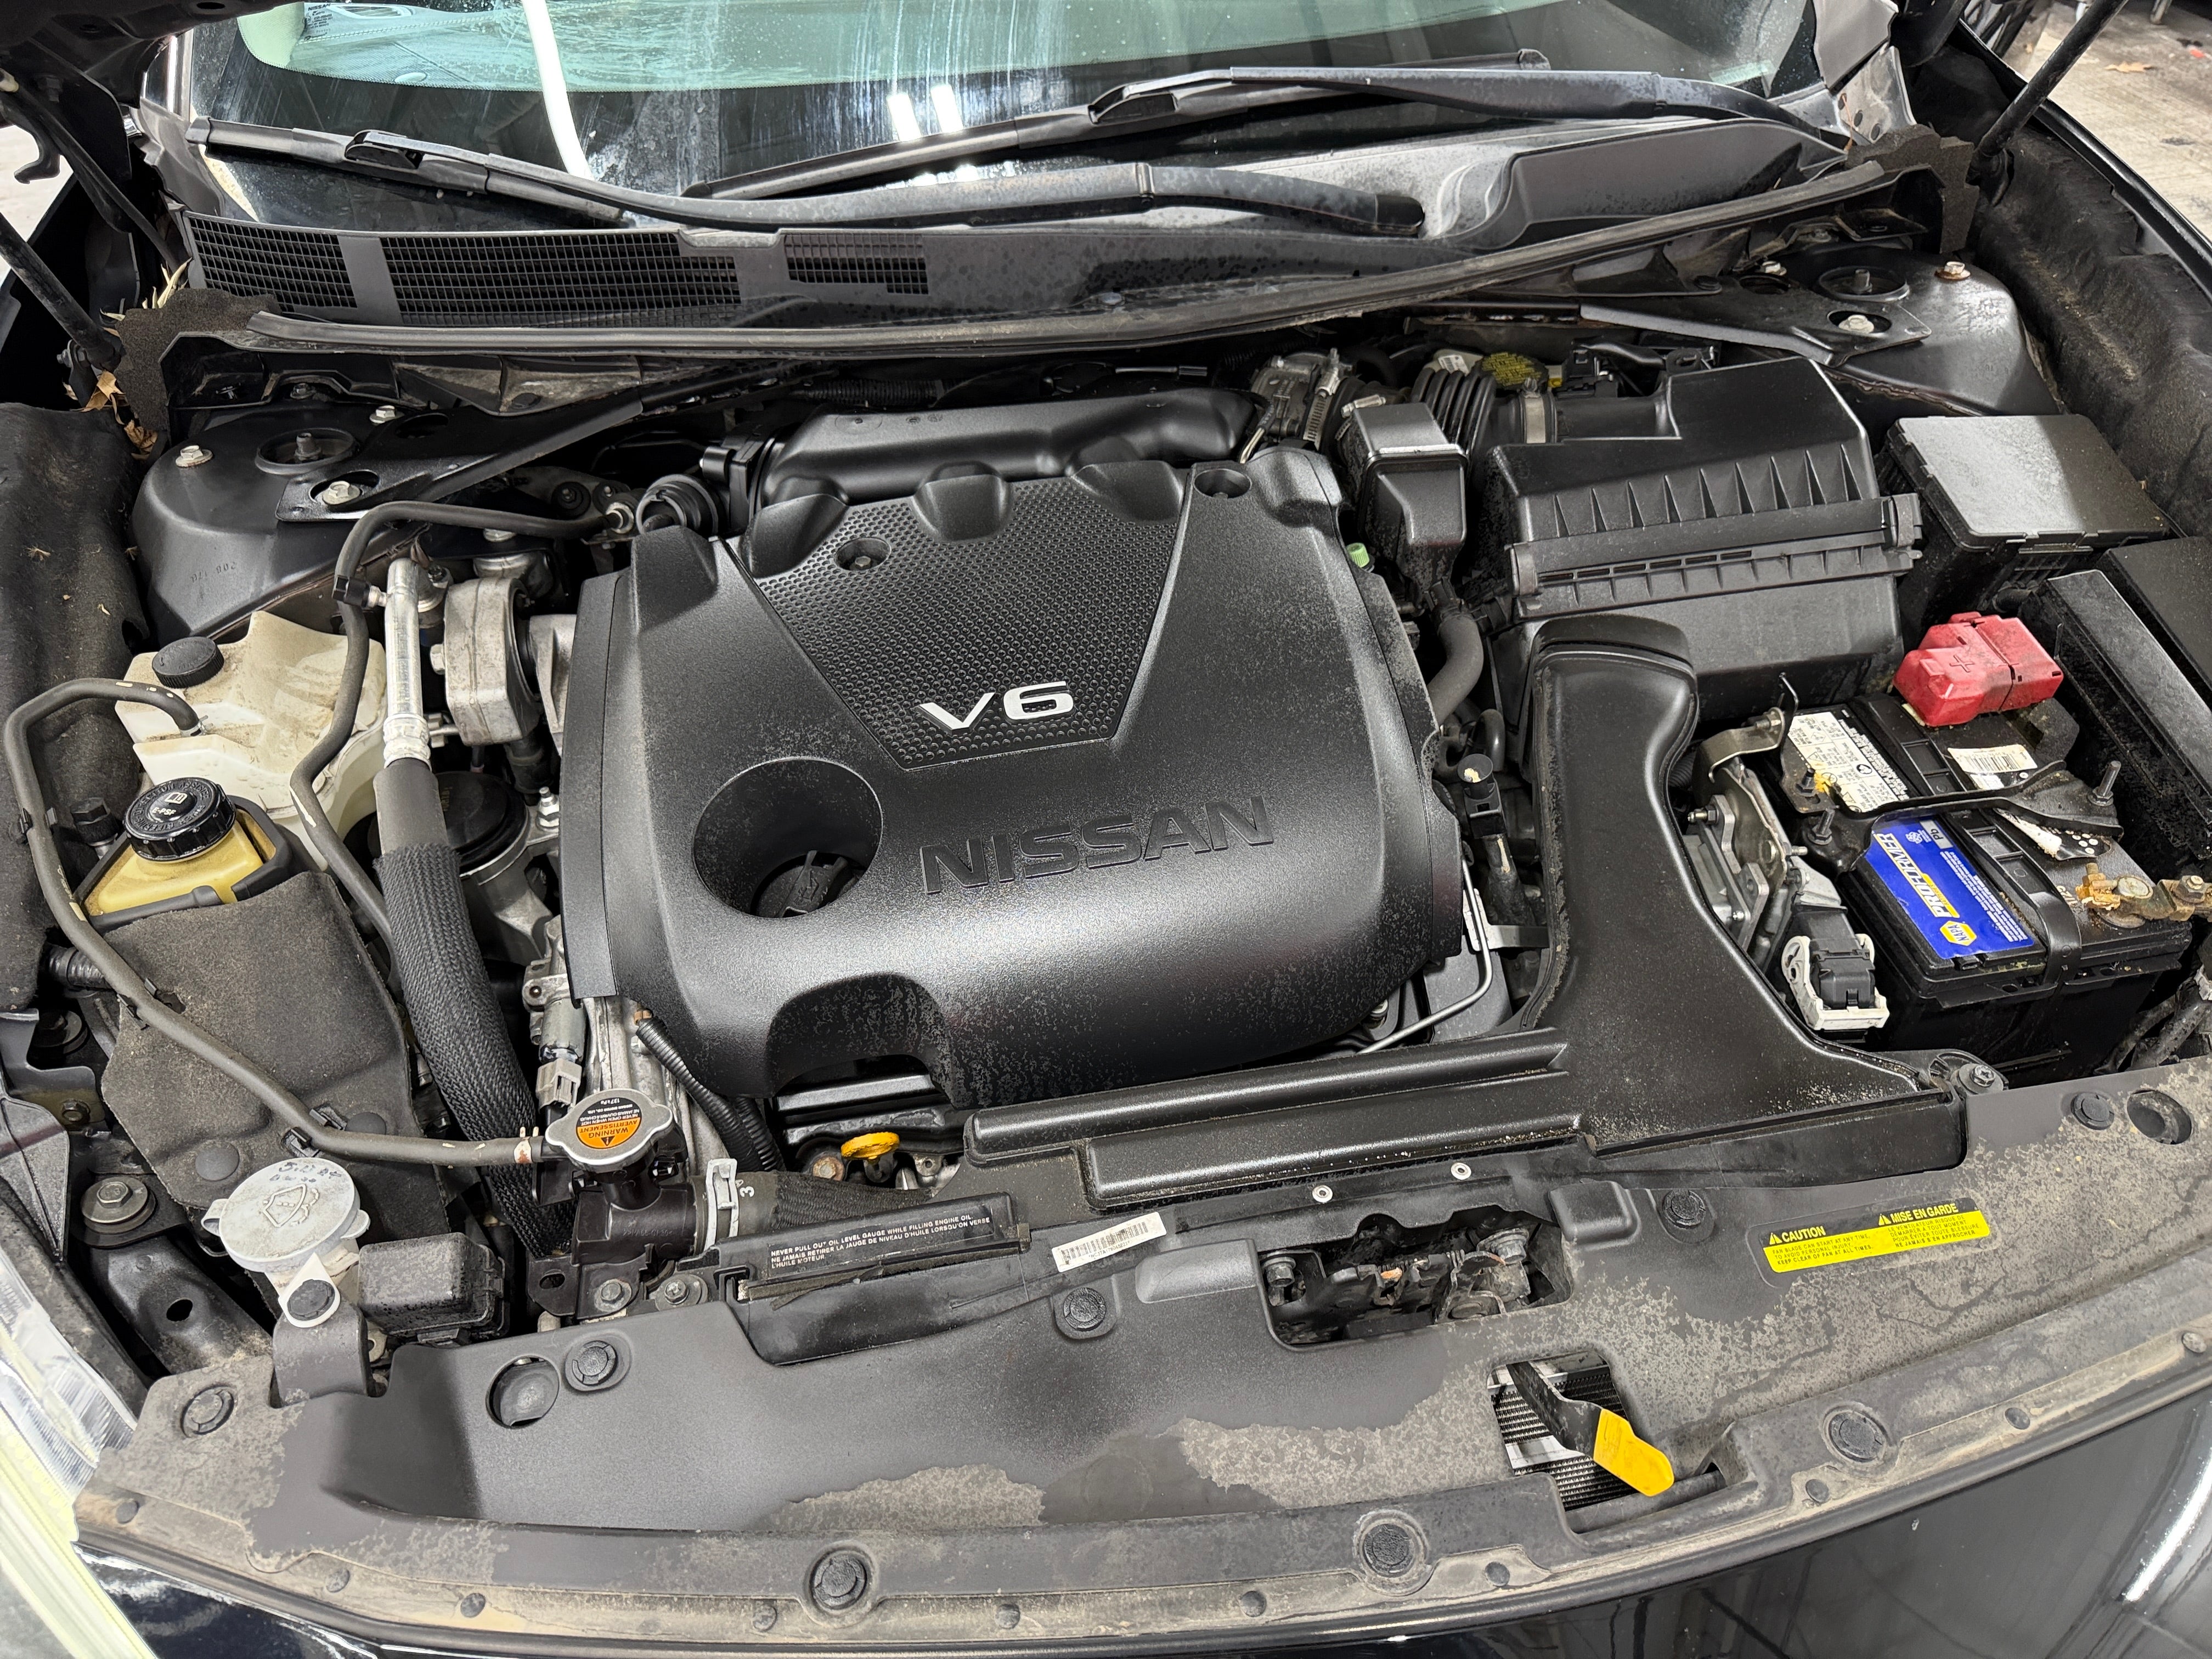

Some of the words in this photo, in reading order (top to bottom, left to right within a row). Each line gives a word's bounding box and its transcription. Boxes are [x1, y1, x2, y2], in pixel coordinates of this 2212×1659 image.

[917, 680, 1074, 733] V6
[151, 806, 177, 816] E-PSF
[1930, 828, 1943, 840] Pb
[920, 795, 1274, 894] NISSAN
[1878, 833, 1953, 917] PROFORMER
[1948, 924, 1970, 942] NAPA
[579, 1119, 637, 1133] AVERTISSEMENT
[588, 1127, 629, 1138] WARNING
[740, 1186, 754, 1197] 3
[1890, 1210, 1914, 1223] MISE
[1912, 1208, 1927, 1219] EN
[1927, 1203, 1959, 1217] GARDE
[1897, 1220, 1933, 1231] VENTILATEUR
[1934, 1216, 1956, 1224] RISQUE
[771, 1248, 793, 1256] NEVER
[795, 1244, 811, 1252] PULL
[842, 1234, 860, 1243] LEVEL
[862, 1230, 885, 1238] GAUGE
[888, 1227, 907, 1235] WHILE
[909, 1221, 933, 1231] FILLING
[935, 1216, 959, 1226] ENGINE
[782, 1252, 806, 1262] JAMAIS
[808, 1248, 834, 1257] RETIRER
[846, 1240, 866, 1249] JAUGE
[879, 1233, 903, 1242] NIVEAU
[905, 1229, 929, 1239] D'HUILE
[931, 1221, 968, 1233] LORSQU'ON
[969, 1217, 990, 1226] VERSE
[1781, 1226, 1826, 1242] CAUTION
[1785, 1244, 1802, 1252] BLADE
[1905, 1238, 1926, 1246] JAMAIS
[1784, 1250, 1800, 1259] AVOID
[1802, 1246, 1830, 1255] PERSONAL
[1794, 1254, 1812, 1263] CLEAR
[771, 1260, 795, 1269] L'HUILE
[798, 1255, 825, 1264] MOTEUR
